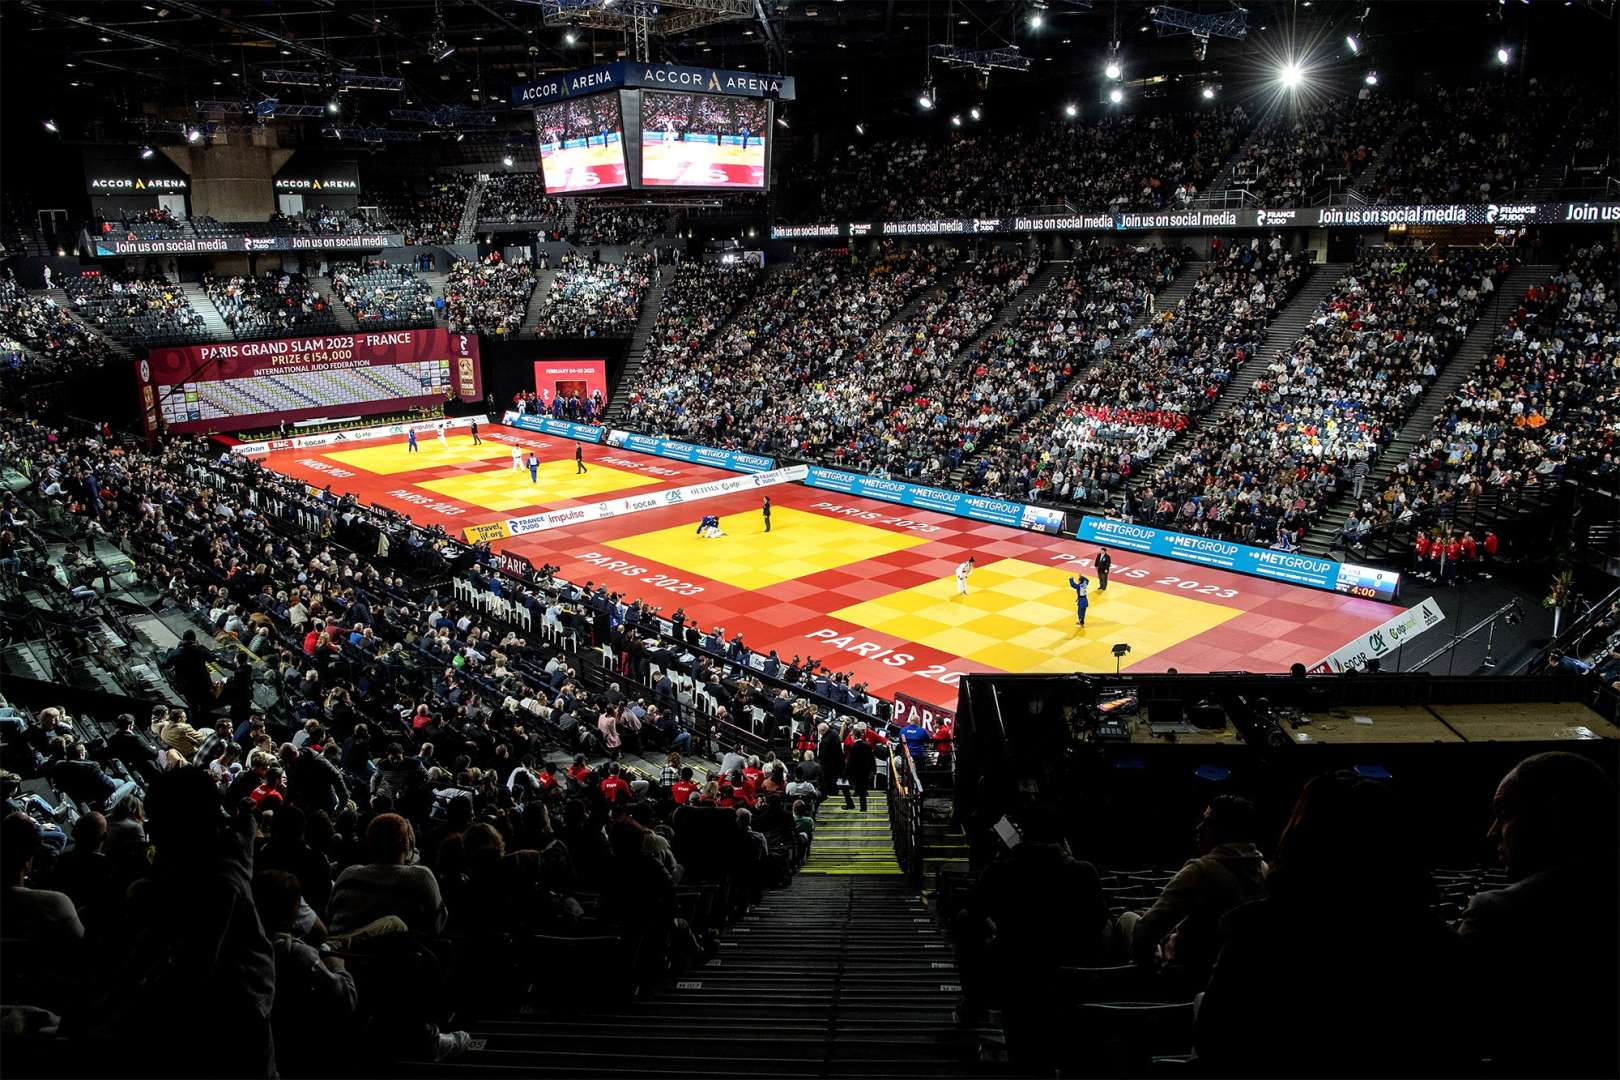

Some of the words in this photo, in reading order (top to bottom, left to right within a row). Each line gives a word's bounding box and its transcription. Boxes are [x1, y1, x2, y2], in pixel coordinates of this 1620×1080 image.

[522, 82, 558, 101] ACCOR
[572, 70, 612, 90] ARENA
[644, 69, 702, 86] ACCOR
[726, 77, 779, 93] ARENA
[92, 179, 133, 188] ACCOR
[147, 179, 187, 188] ARENA
[276, 180, 311, 188] ACCOR
[323, 180, 357, 188] ARENA
[1318, 208, 1343, 223] Join
[1345, 210, 1361, 223] us
[1362, 210, 1379, 223] on
[1380, 206, 1421, 222] social
[1422, 205, 1466, 221] media
[1500, 206, 1537, 214] FRANCE
[1566, 203, 1598, 220] Join
[1601, 206, 1620, 220] us
[883, 222, 897, 234] Join
[898, 223, 907, 233] us
[907, 222, 917, 233] on
[917, 220, 939, 232] social
[939, 219, 963, 232] media
[1014, 217, 1032, 230] Join
[1032, 219, 1044, 229] us
[1044, 218, 1055, 229] on
[1056, 215, 1083, 229] social
[1084, 214, 1113, 228] media
[1121, 214, 1141, 228] Join
[1142, 216, 1157, 227] us
[1157, 215, 1168, 226] on
[1170, 212, 1201, 226] social
[1202, 211, 1236, 225] media
[774, 226, 785, 237] Join
[785, 227, 793, 236] us
[793, 227, 801, 236] on
[801, 225, 819, 236] social
[819, 224, 839, 235] media
[115, 241, 137, 253] Join
[138, 242, 153, 252] us
[153, 241, 165, 252] on
[166, 239, 196, 251] social
[197, 239, 228, 250] media
[292, 236, 311, 248] Join
[312, 238, 323, 247] us
[323, 237, 335, 247] on
[335, 235, 361, 247] social
[362, 235, 388, 246] media
[201, 345, 238, 360] PARIS
[241, 341, 288, 356] GRAND
[291, 339, 324, 352] SLAM
[326, 336, 354, 350] 2023
[366, 332, 411, 346] FRANCE
[271, 353, 301, 366] PRIZE
[253, 365, 310, 377] INTERNATIONAL
[310, 363, 329, 371] JUDO
[330, 360, 370, 370] FEDERATION
[699, 448, 730, 460] METGROUP
[736, 454, 769, 466] METGROUP
[817, 470, 855, 483] METGROUP
[864, 479, 906, 492] METGROUP
[915, 487, 960, 503] METGROUP
[632, 499, 657, 510] SOCAR
[971, 498, 1020, 514] METGROUP
[518, 516, 545, 526] FRANCE
[548, 510, 584, 523] impulse
[809, 501, 882, 520] PARIS
[880, 517, 941, 533] 2023
[520, 523, 540, 532] JUDO
[1097, 522, 1155, 540] METGROUP
[480, 530, 504, 541] ijf.org
[1173, 535, 1238, 556] METGROUP
[1259, 552, 1331, 574] METGROUP
[575, 551, 648, 576] PARIS
[640, 574, 705, 596] 2023
[1050, 552, 1150, 578] PAIS
[1155, 575, 1240, 598] 2023
[1351, 586, 1376, 598] 4:00
[804, 628, 915, 667] PARIS
[912, 664, 971, 689] 20
[1343, 651, 1369, 671] SOCAR
